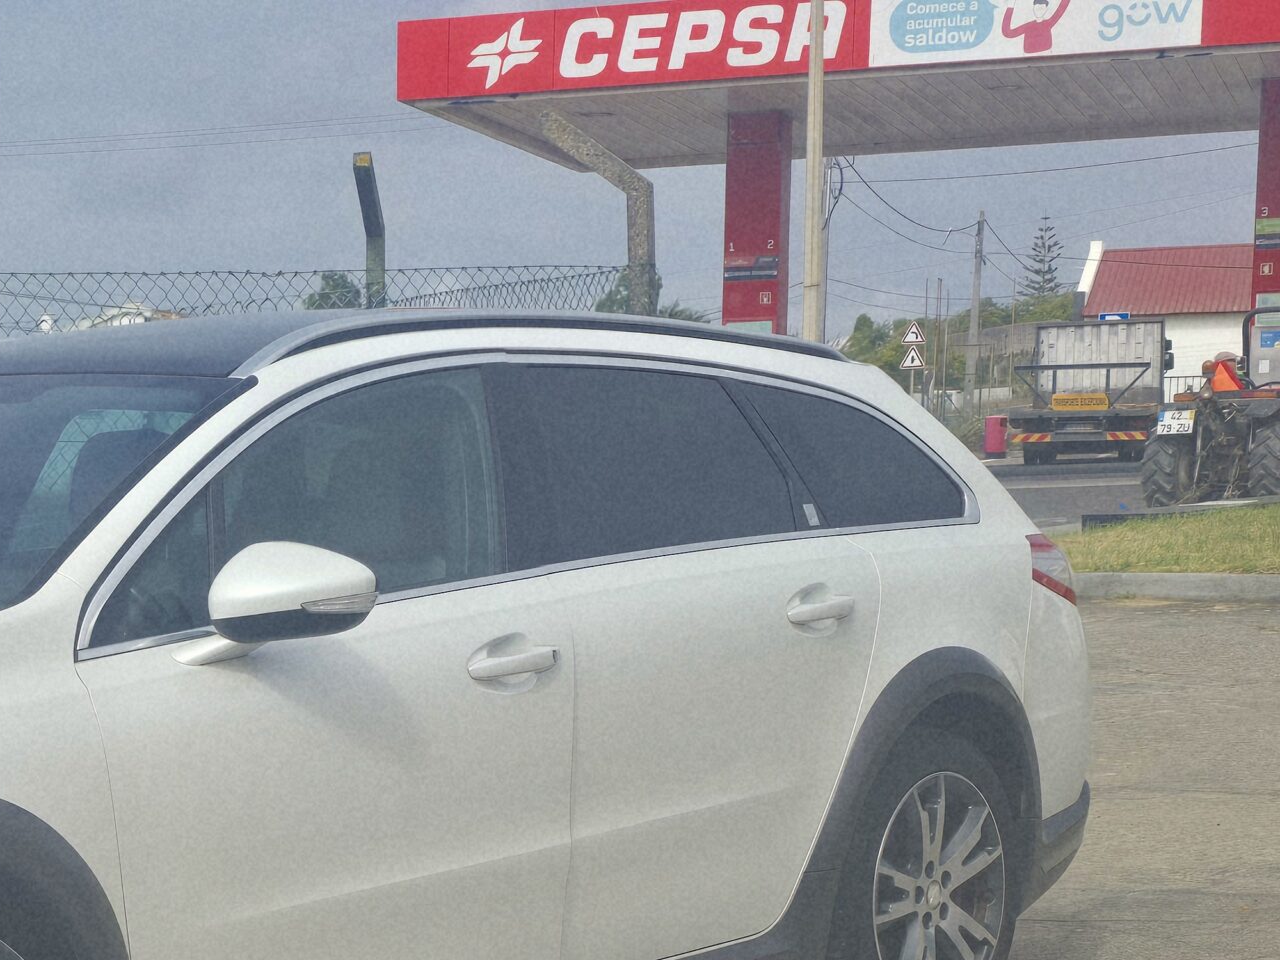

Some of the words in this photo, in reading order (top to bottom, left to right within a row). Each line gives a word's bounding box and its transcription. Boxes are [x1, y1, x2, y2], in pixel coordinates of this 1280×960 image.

[906, 1, 966, 15] Comece
[969, 1, 978, 11] a
[906, 14, 977, 30] acumular
[559, 0, 847, 78] CEPSA
[904, 28, 977, 47] saldow
[729, 242, 735, 252] 1
[767, 239, 775, 249] 2
